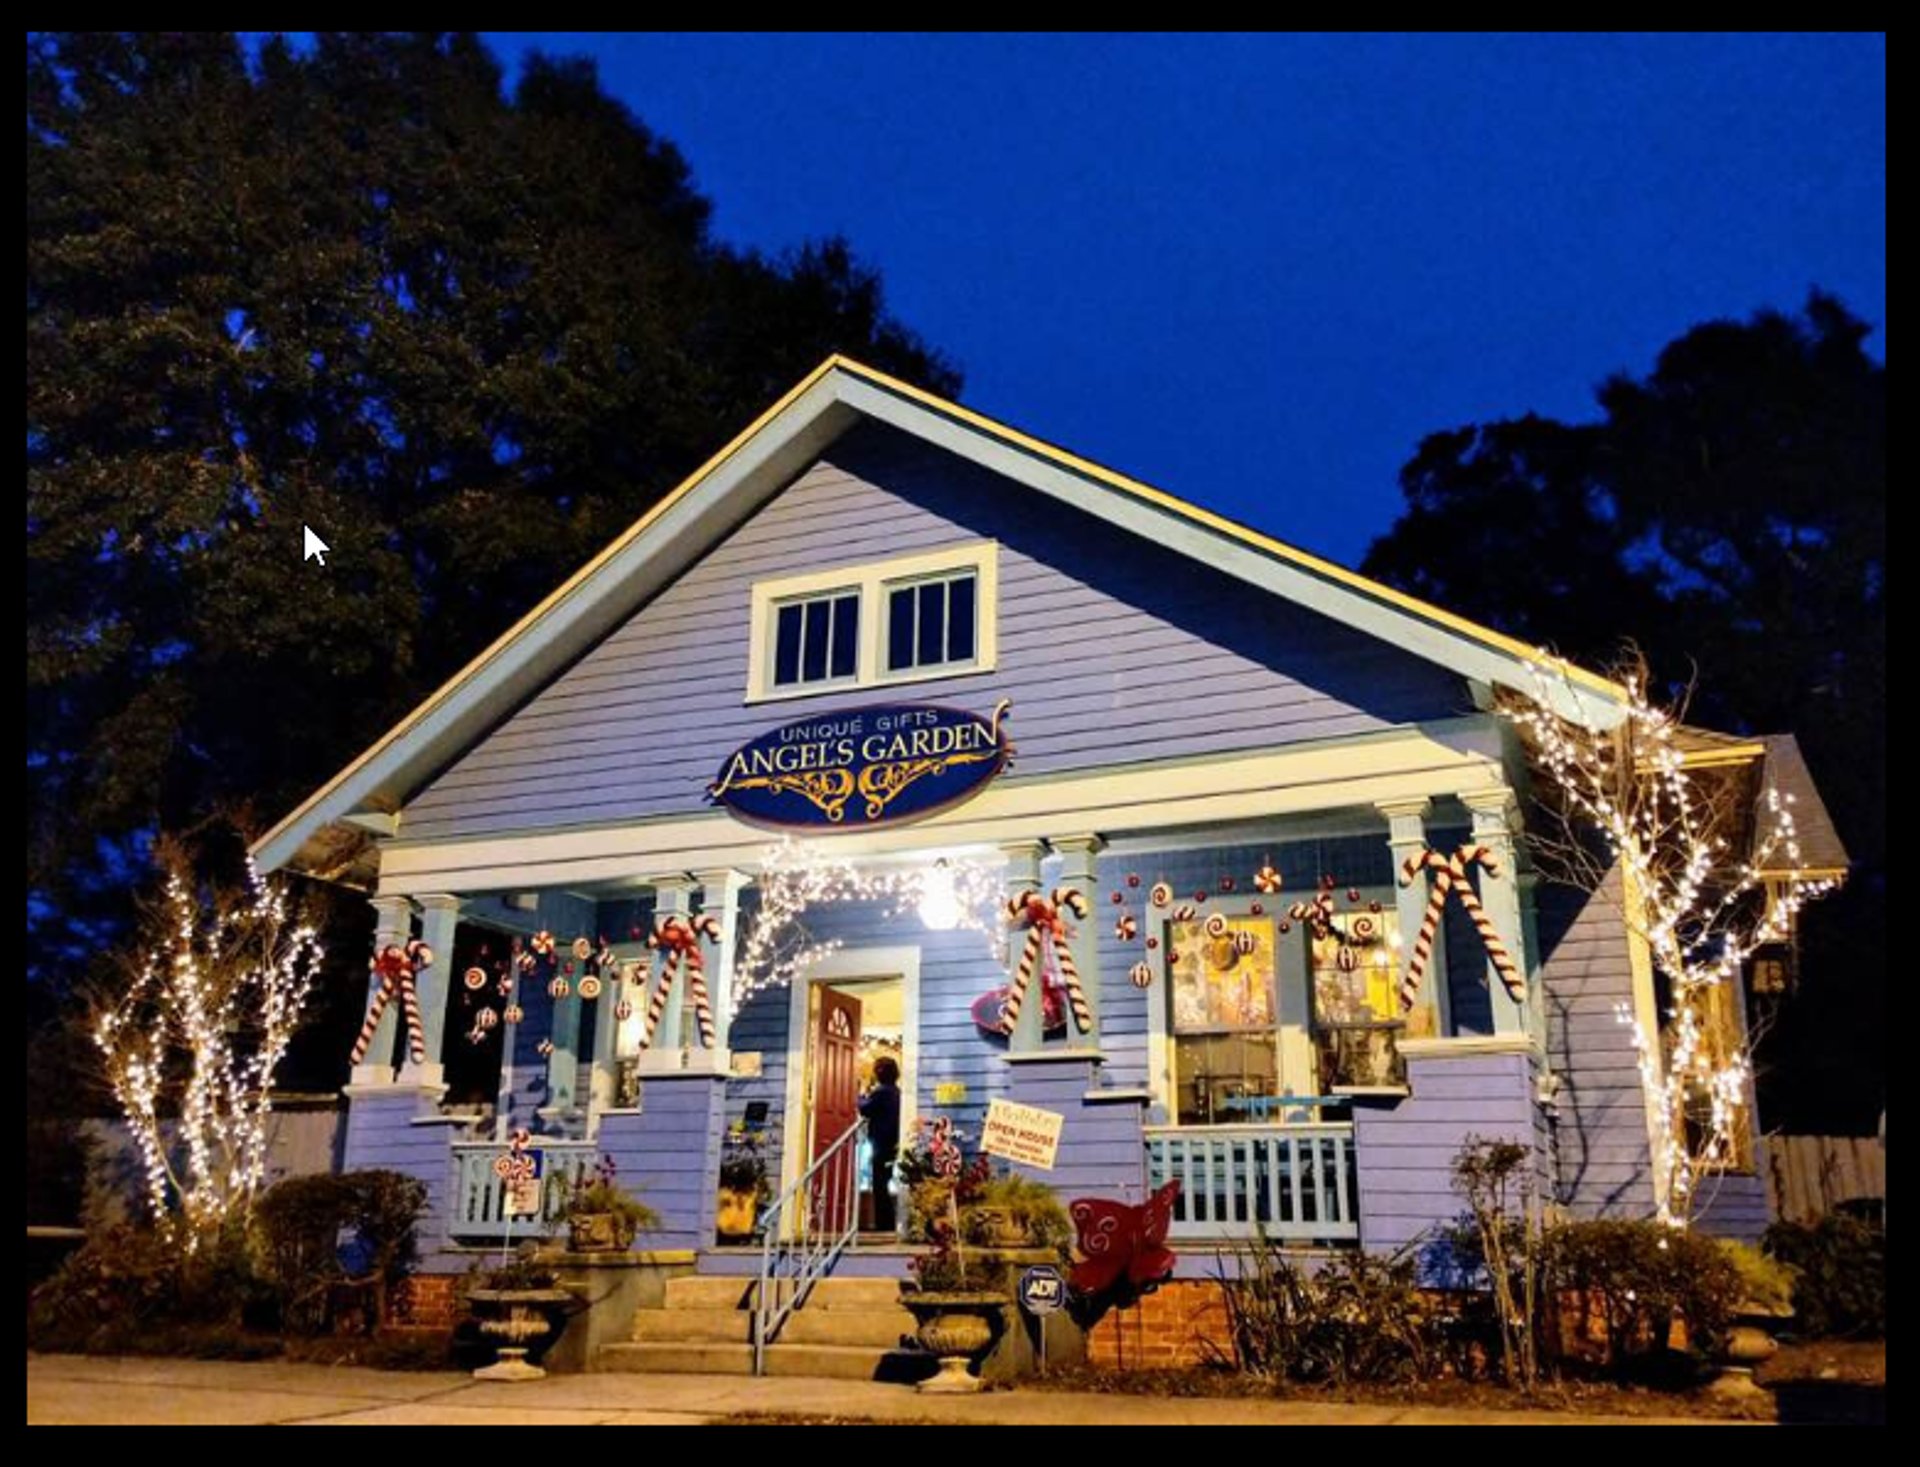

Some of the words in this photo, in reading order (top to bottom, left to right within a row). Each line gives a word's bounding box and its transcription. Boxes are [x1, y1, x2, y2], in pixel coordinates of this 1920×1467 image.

[780, 718, 862, 742] UNIQUE
[876, 709, 939, 732] GIFTS
[716, 737, 855, 791] ANGEL'S
[861, 706, 1005, 763] GARDEN
[987, 1120, 1016, 1137] OPEN
[1026, 1279, 1058, 1298] ADT
